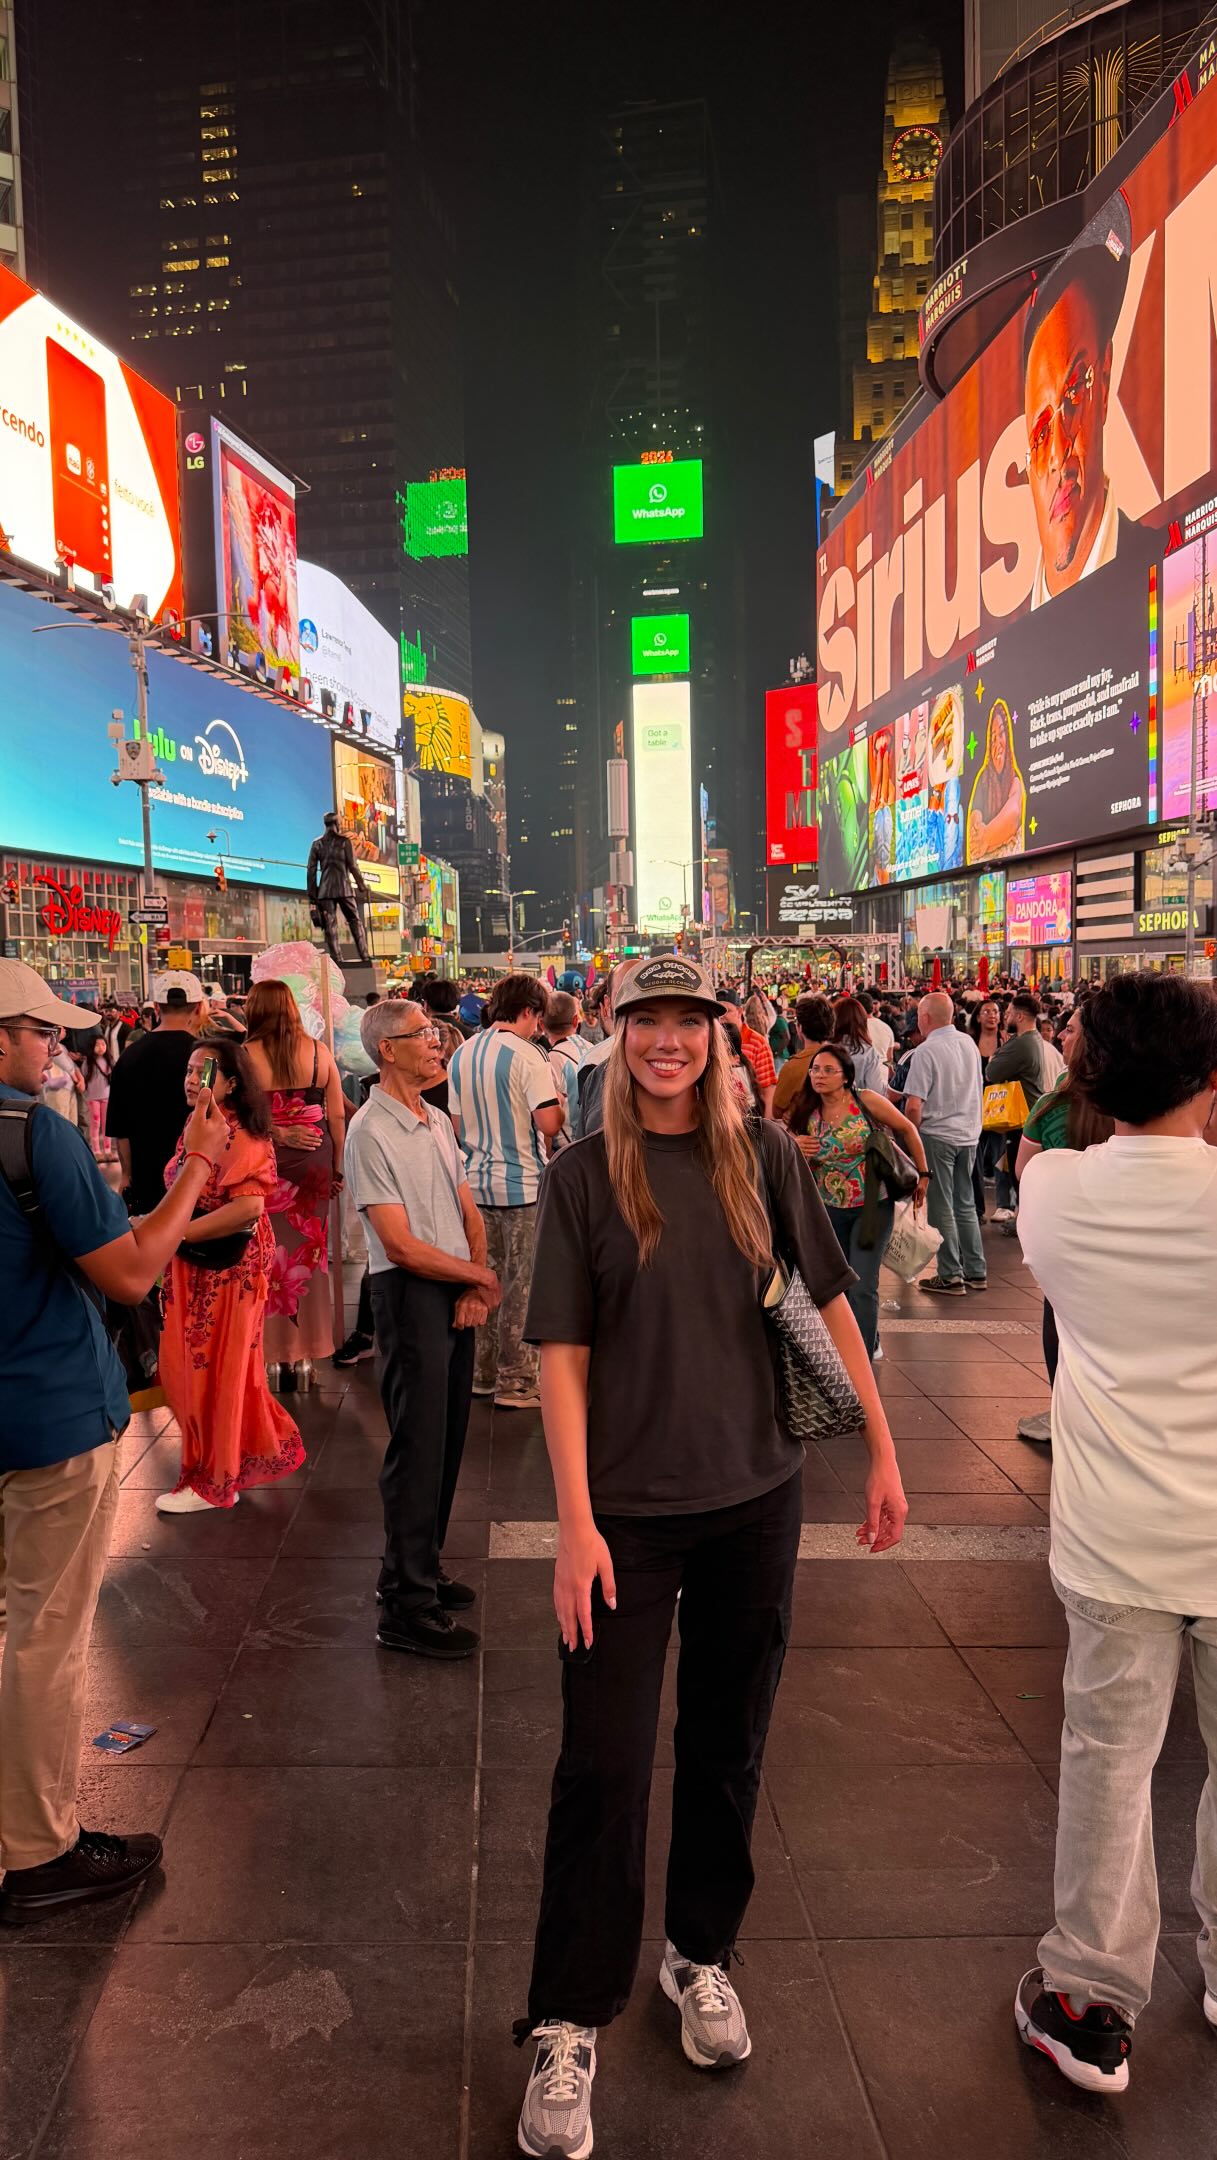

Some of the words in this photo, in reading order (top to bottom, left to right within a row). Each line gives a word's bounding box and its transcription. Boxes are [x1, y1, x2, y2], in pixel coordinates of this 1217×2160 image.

[925, 259, 968, 315] MARRIOTT
[925, 284, 961, 335] MARQUIS
[0, 406, 45, 448] cendo
[186, 456, 205, 470] LG
[632, 506, 685, 519] WhatsApp
[642, 648, 679, 656] WhatsApp
[1059, 684, 1079, 705] power
[1078, 674, 1091, 694] and
[1096, 684, 1110, 703] and
[1109, 670, 1140, 698] unafraid
[1072, 710, 1094, 732] exactly
[180, 744, 193, 761] ON
[195, 734, 249, 791] Disney+
[1110, 796, 1142, 815] SEPHORA
[34, 875, 122, 954] Disney
